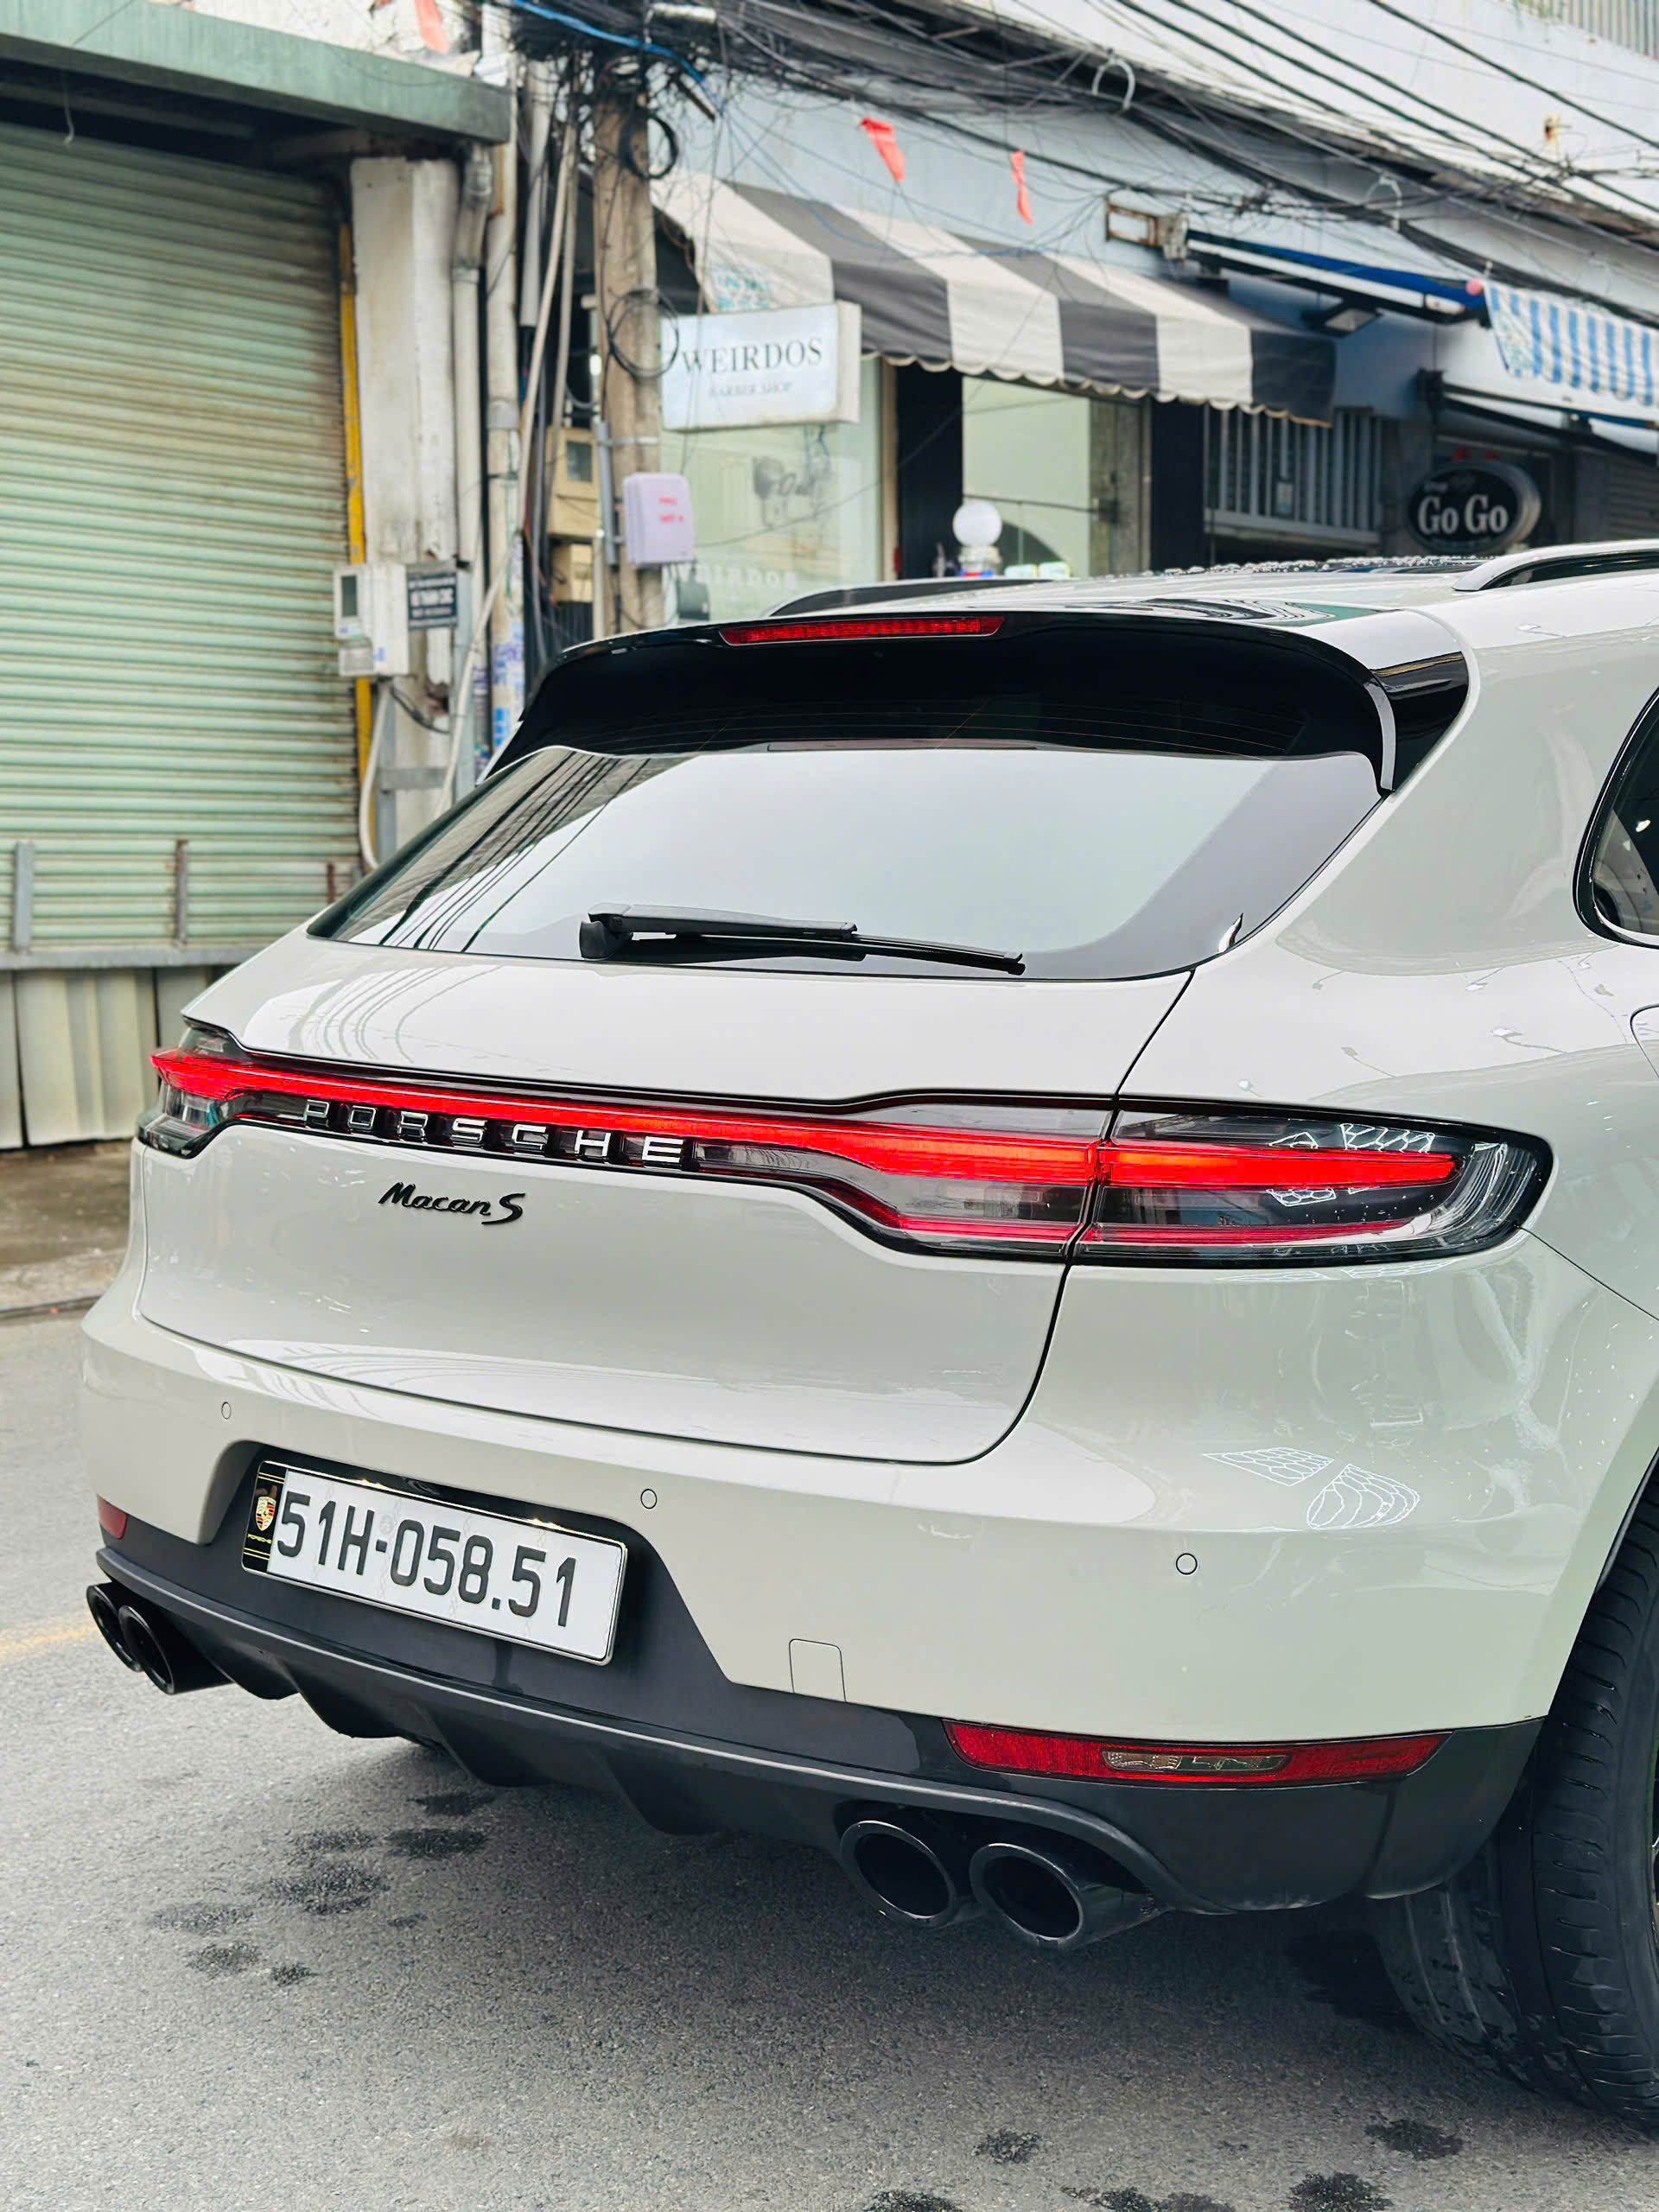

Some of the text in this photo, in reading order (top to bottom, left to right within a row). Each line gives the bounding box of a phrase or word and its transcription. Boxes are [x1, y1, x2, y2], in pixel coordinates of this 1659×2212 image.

[682, 337, 823, 373] WEIRDOS
[761, 380, 792, 395] SHOP
[1418, 493, 1509, 535] Go Go
[303, 1098, 684, 1165] PORSCHE
[378, 1182, 526, 1225] Macan S
[276, 1491, 577, 1628] 51H-058.51
